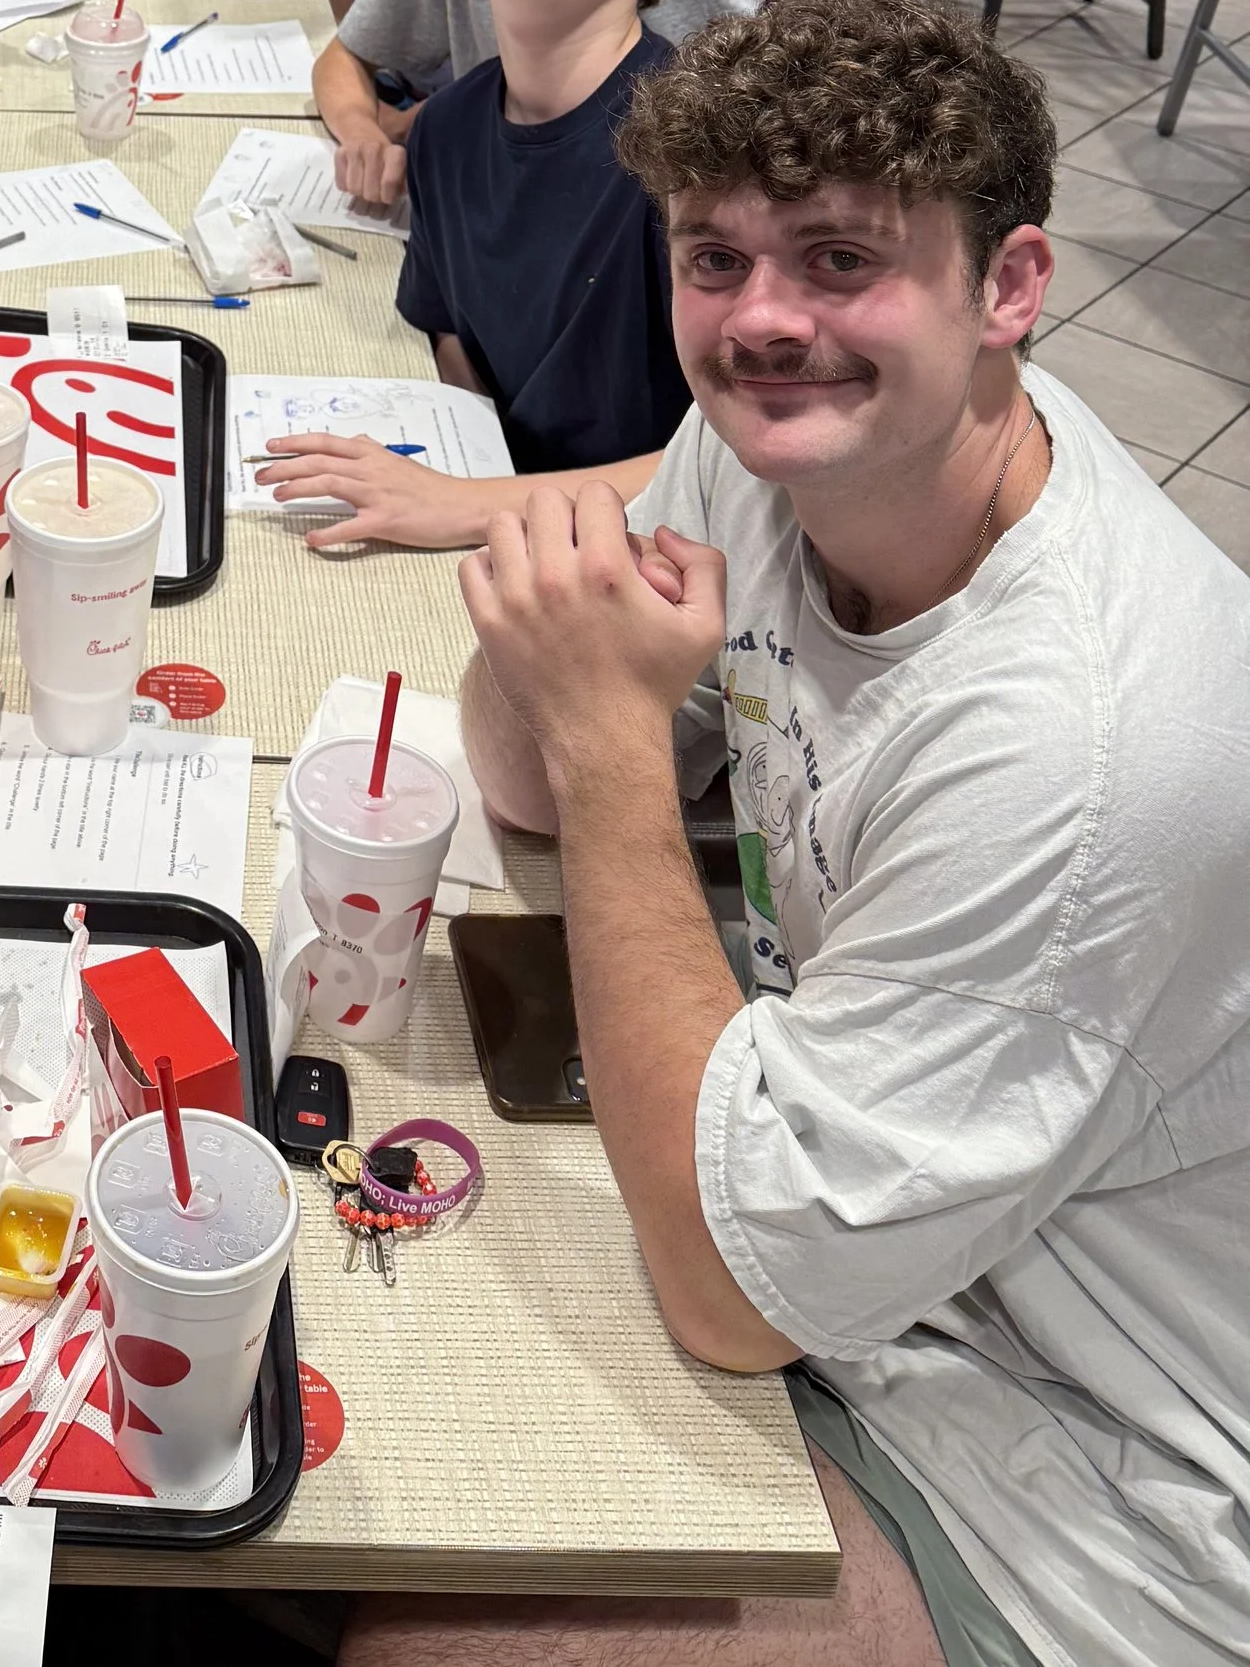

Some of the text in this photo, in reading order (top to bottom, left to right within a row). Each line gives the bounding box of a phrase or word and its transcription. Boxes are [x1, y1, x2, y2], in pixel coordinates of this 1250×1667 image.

[803, 738, 822, 792] His
[170, 838, 178, 853] doing
[341, 939, 363, 954] 8370
[389, 1195, 417, 1214] Live
[420, 1194, 456, 1214] MOHO
[298, 1374, 311, 1382] he
[304, 1384, 328, 1393] table
